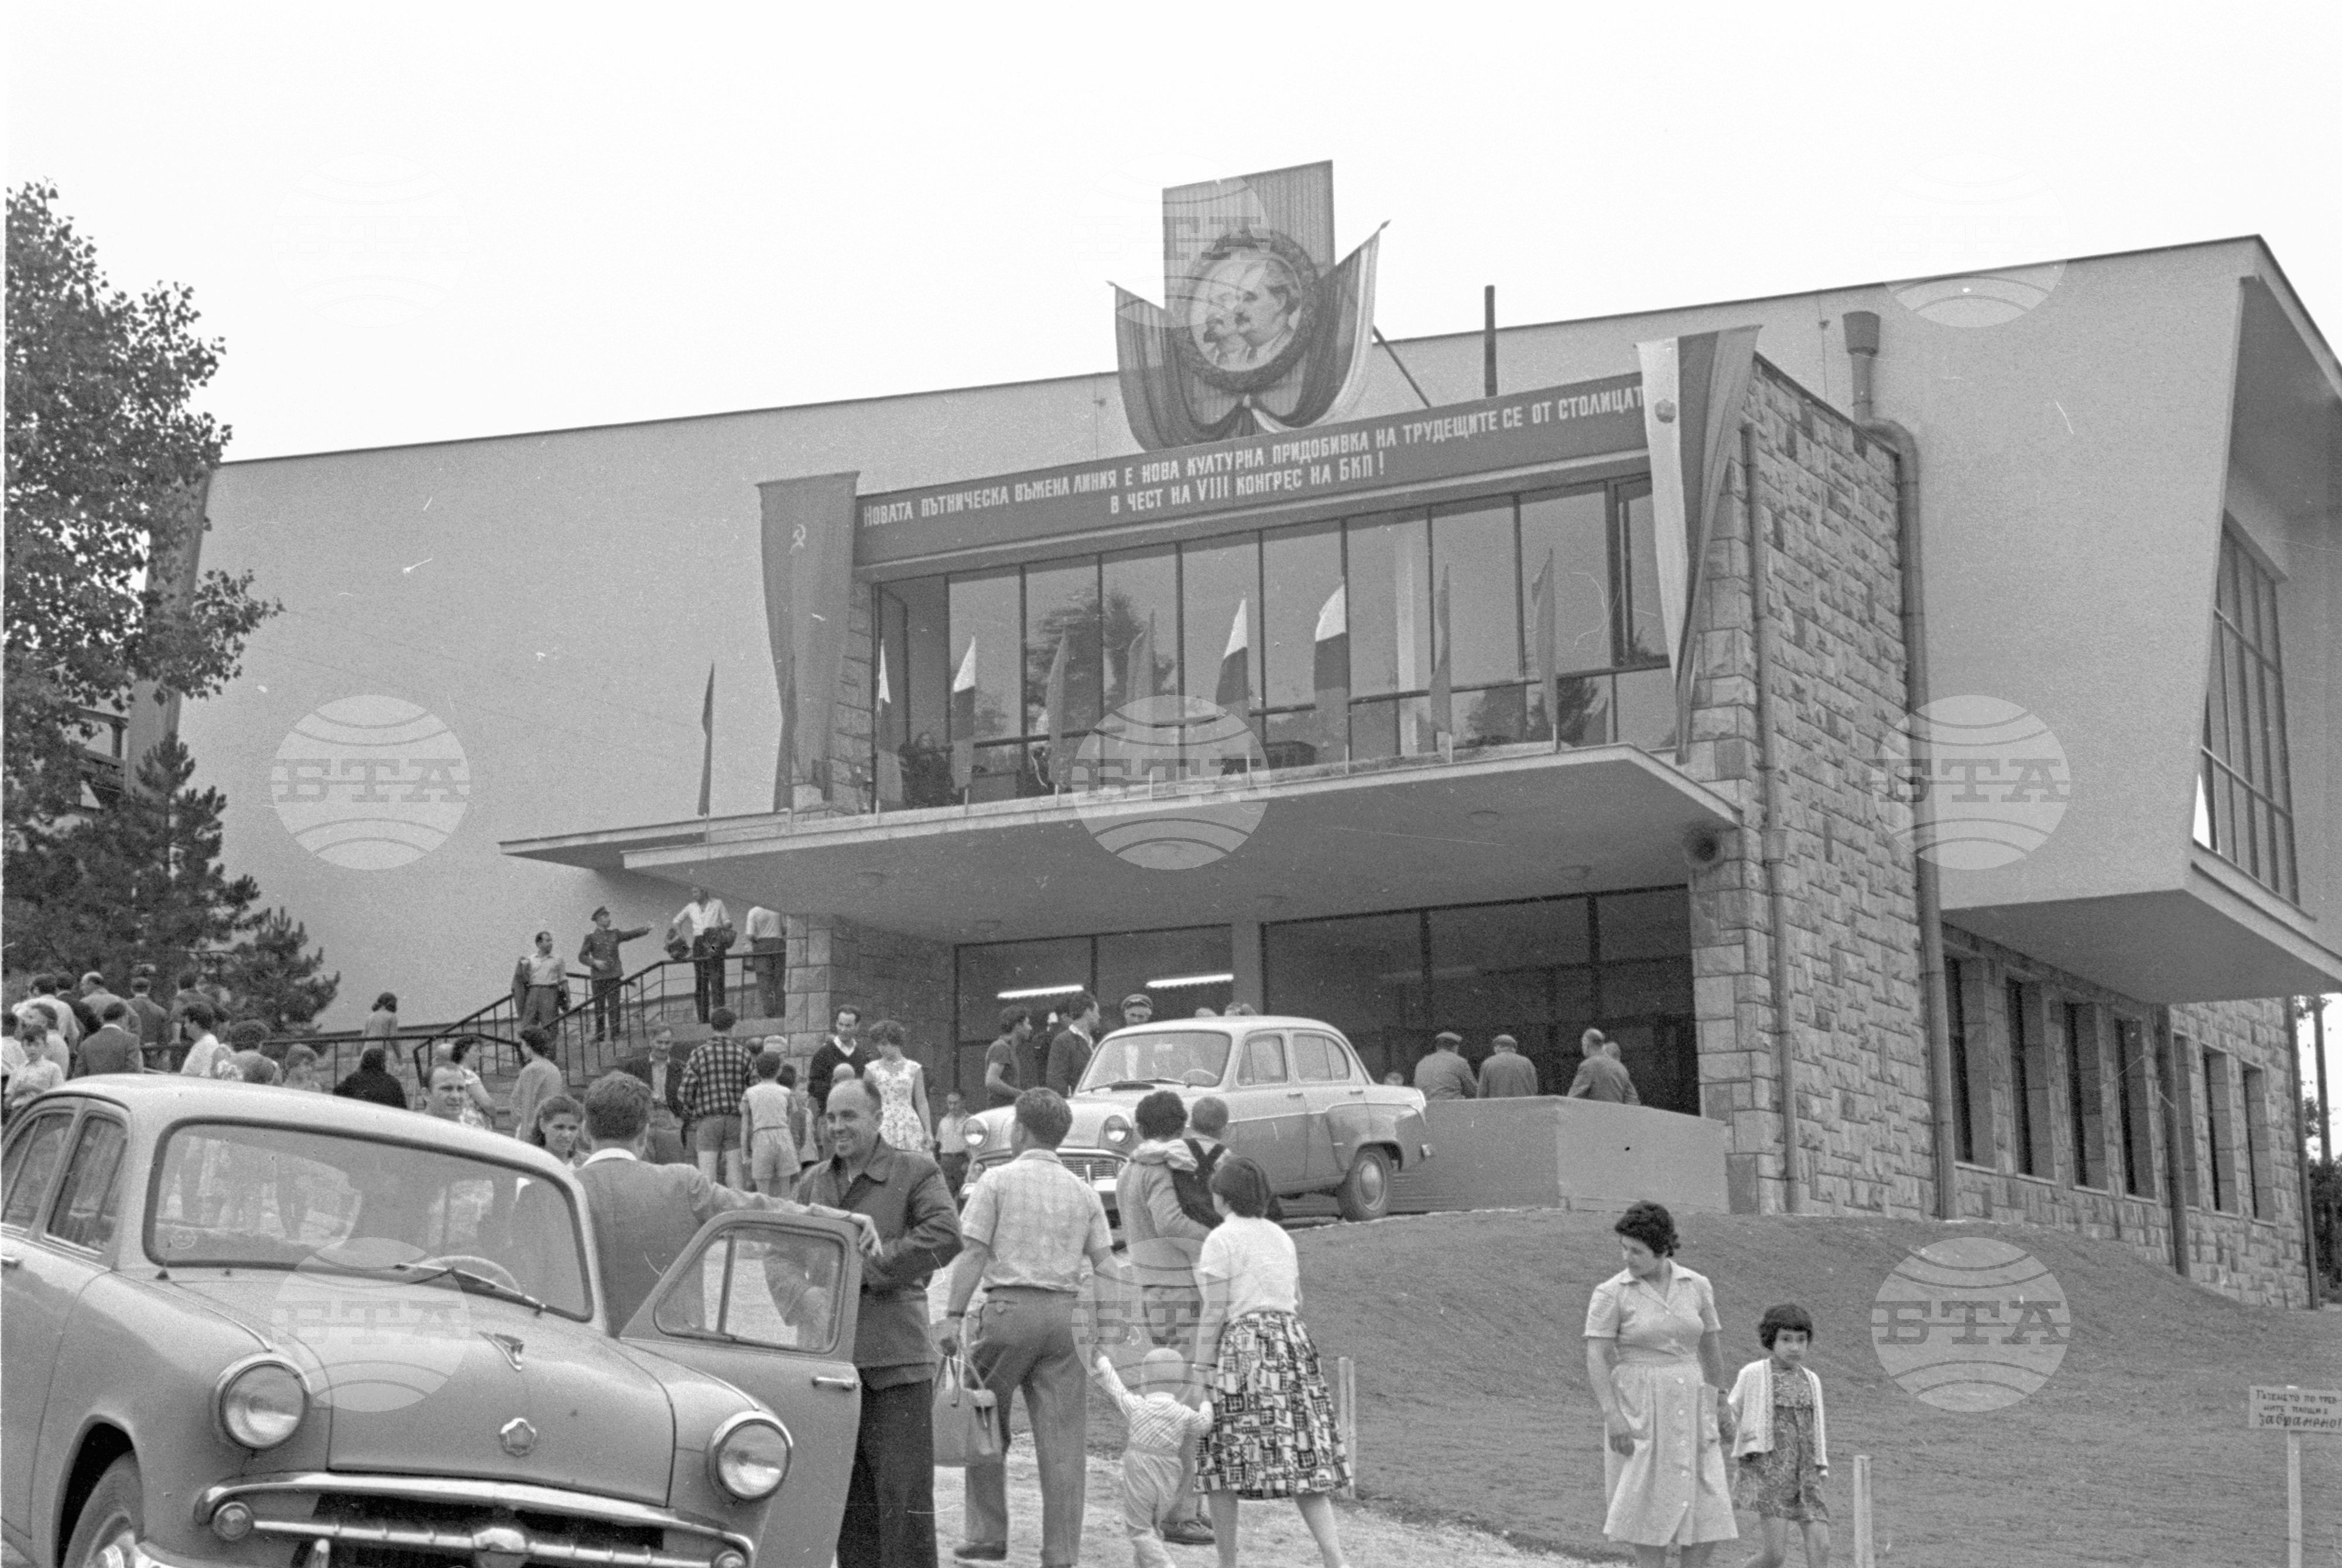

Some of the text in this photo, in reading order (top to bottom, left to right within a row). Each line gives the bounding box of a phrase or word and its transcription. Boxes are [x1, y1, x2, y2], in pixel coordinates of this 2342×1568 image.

[864, 501, 913, 527] НОВАТА
[921, 485, 1009, 518] ПЪТНИЧЕСКА
[1015, 476, 1069, 502] ВЪЖЕНА
[1073, 469, 1117, 494] ЛИНИЯ
[1125, 467, 1133, 486] Е
[1142, 459, 1180, 484] НОВА
[1187, 447, 1264, 477] КУЛТУРНА
[1272, 431, 1369, 464] ПРИДОБИВКА
[1376, 427, 1396, 449] НА
[1403, 410, 1498, 444] ТРУДЕЩИТЕ
[1503, 406, 1522, 429] СЕ
[1532, 401, 1552, 424] ОТ
[1111, 495, 1119, 514] В
[1127, 488, 1163, 511] ЧЕСТ
[1170, 484, 1190, 505] НА
[1196, 475, 1228, 501] VIII
[1236, 468, 1302, 497] КОНГРЕС
[1310, 464, 1331, 485] НА
[1340, 454, 1372, 481] БКП
